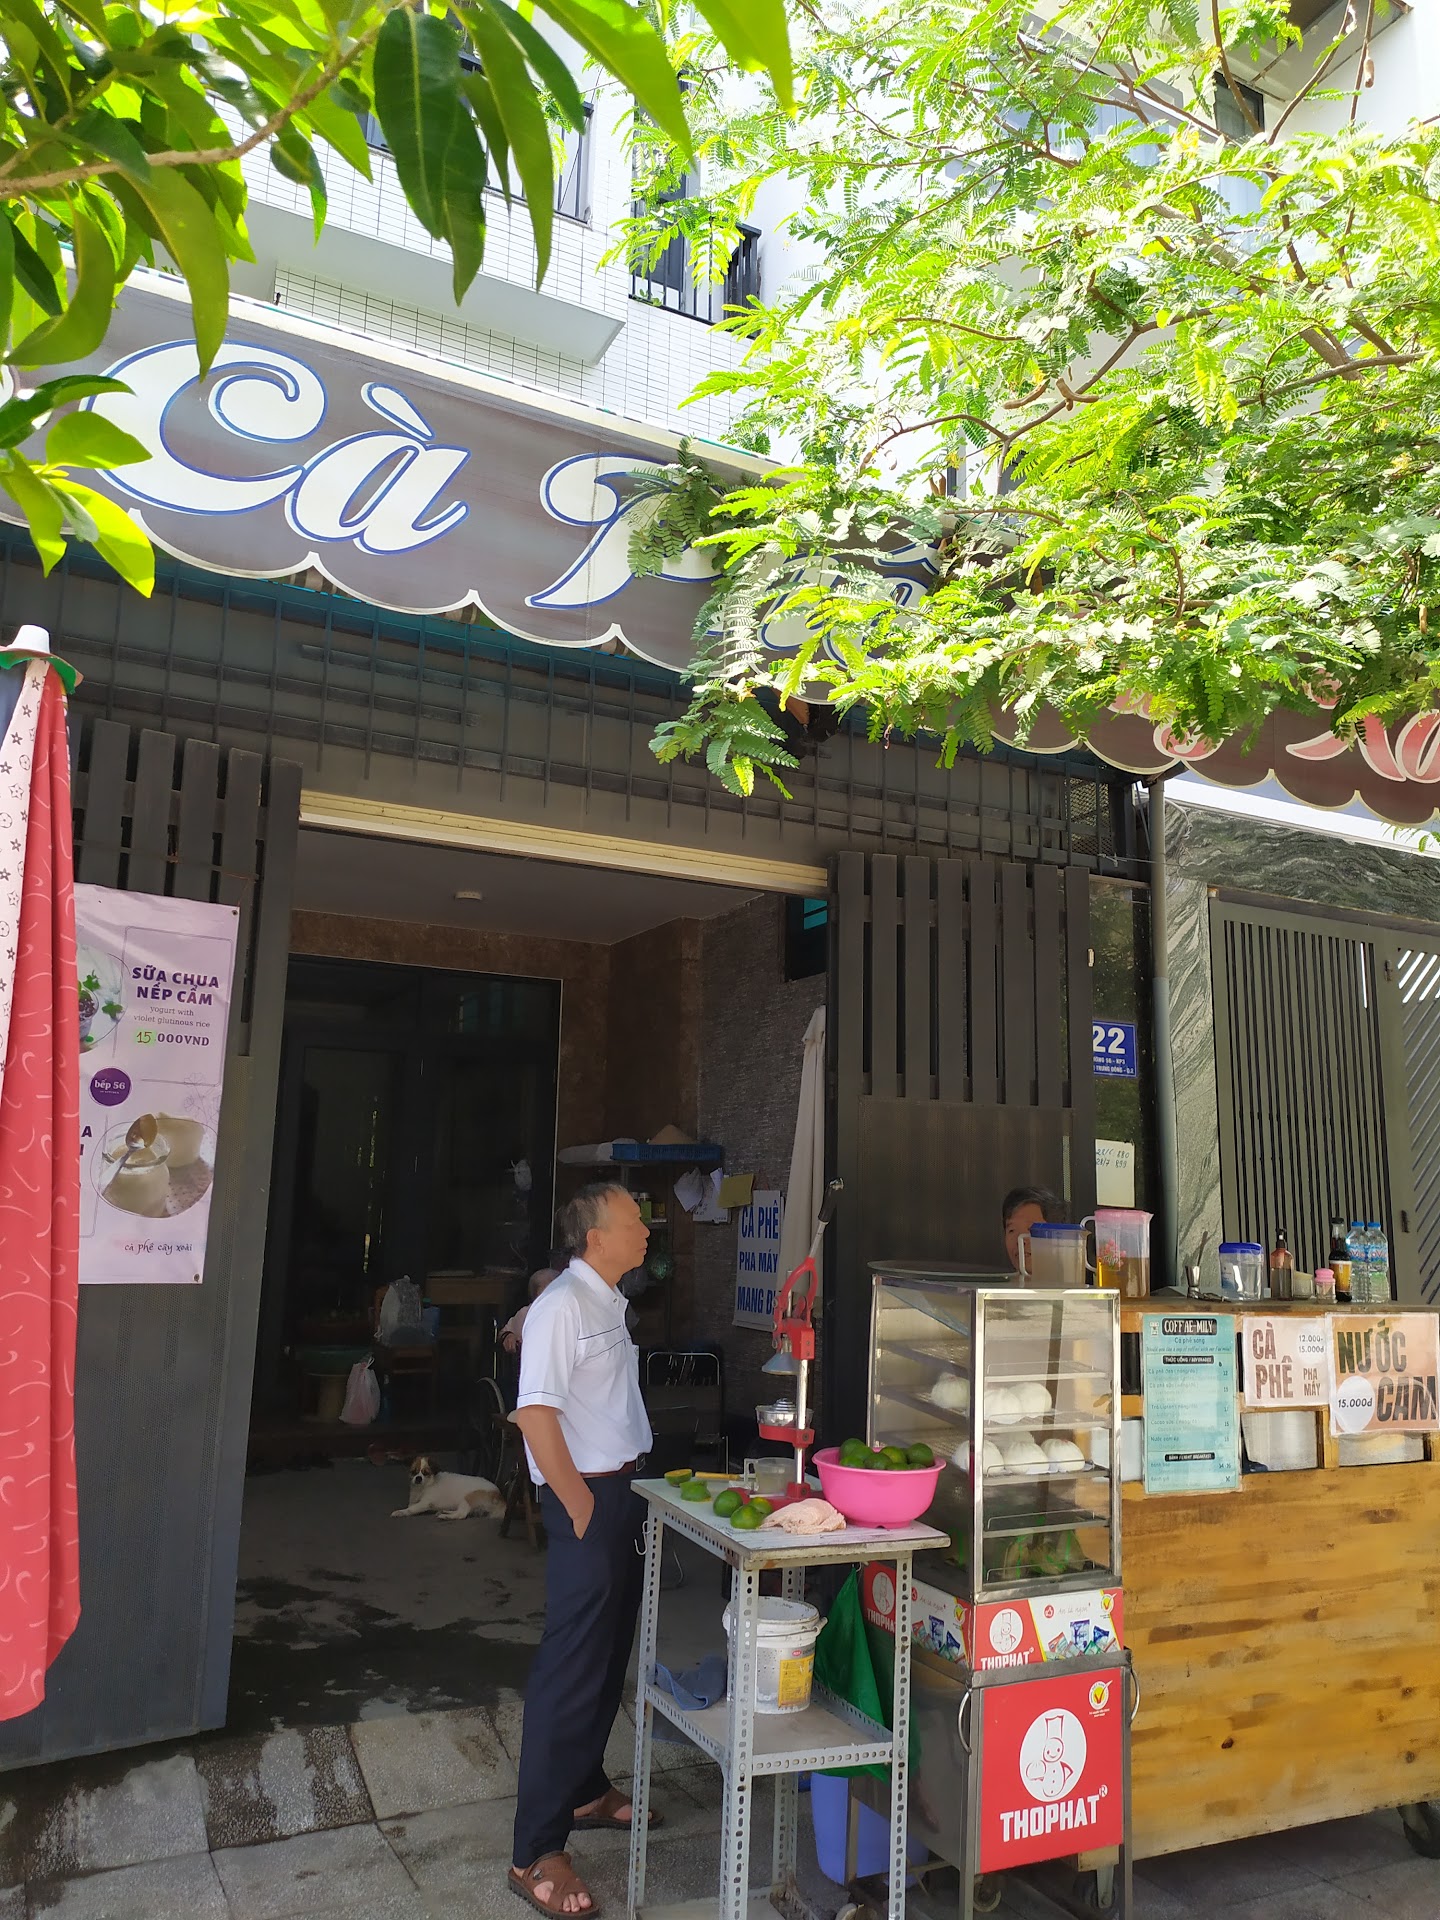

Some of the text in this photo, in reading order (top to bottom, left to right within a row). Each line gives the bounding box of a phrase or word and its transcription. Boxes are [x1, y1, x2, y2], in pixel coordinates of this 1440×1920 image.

[132, 965, 219, 988] SỮA CHUA
[137, 982, 212, 1005] NẾP CẨM
[133, 1014, 155, 1023] violet
[157, 1016, 193, 1026] glutinous
[149, 1005, 175, 1014] yogurt
[94, 1078, 126, 1090] bếp 56
[758, 1199, 779, 1239] PHÊ
[135, 1239, 154, 1255] phê
[739, 1248, 778, 1273] PHA MÁY
[737, 1286, 764, 1314] MANG
[1252, 1321, 1277, 1360] CÀ
[1337, 1318, 1407, 1373] NƯỚC
[1255, 1356, 1294, 1399] PHÊ
[1303, 1368, 1318, 1380] PHA
[1304, 1382, 1321, 1396] MÁY
[1377, 1376, 1437, 1422] CAM
[1338, 1397, 1373, 1408] 15.000đ
[867, 1607, 896, 1633] THOPHA
